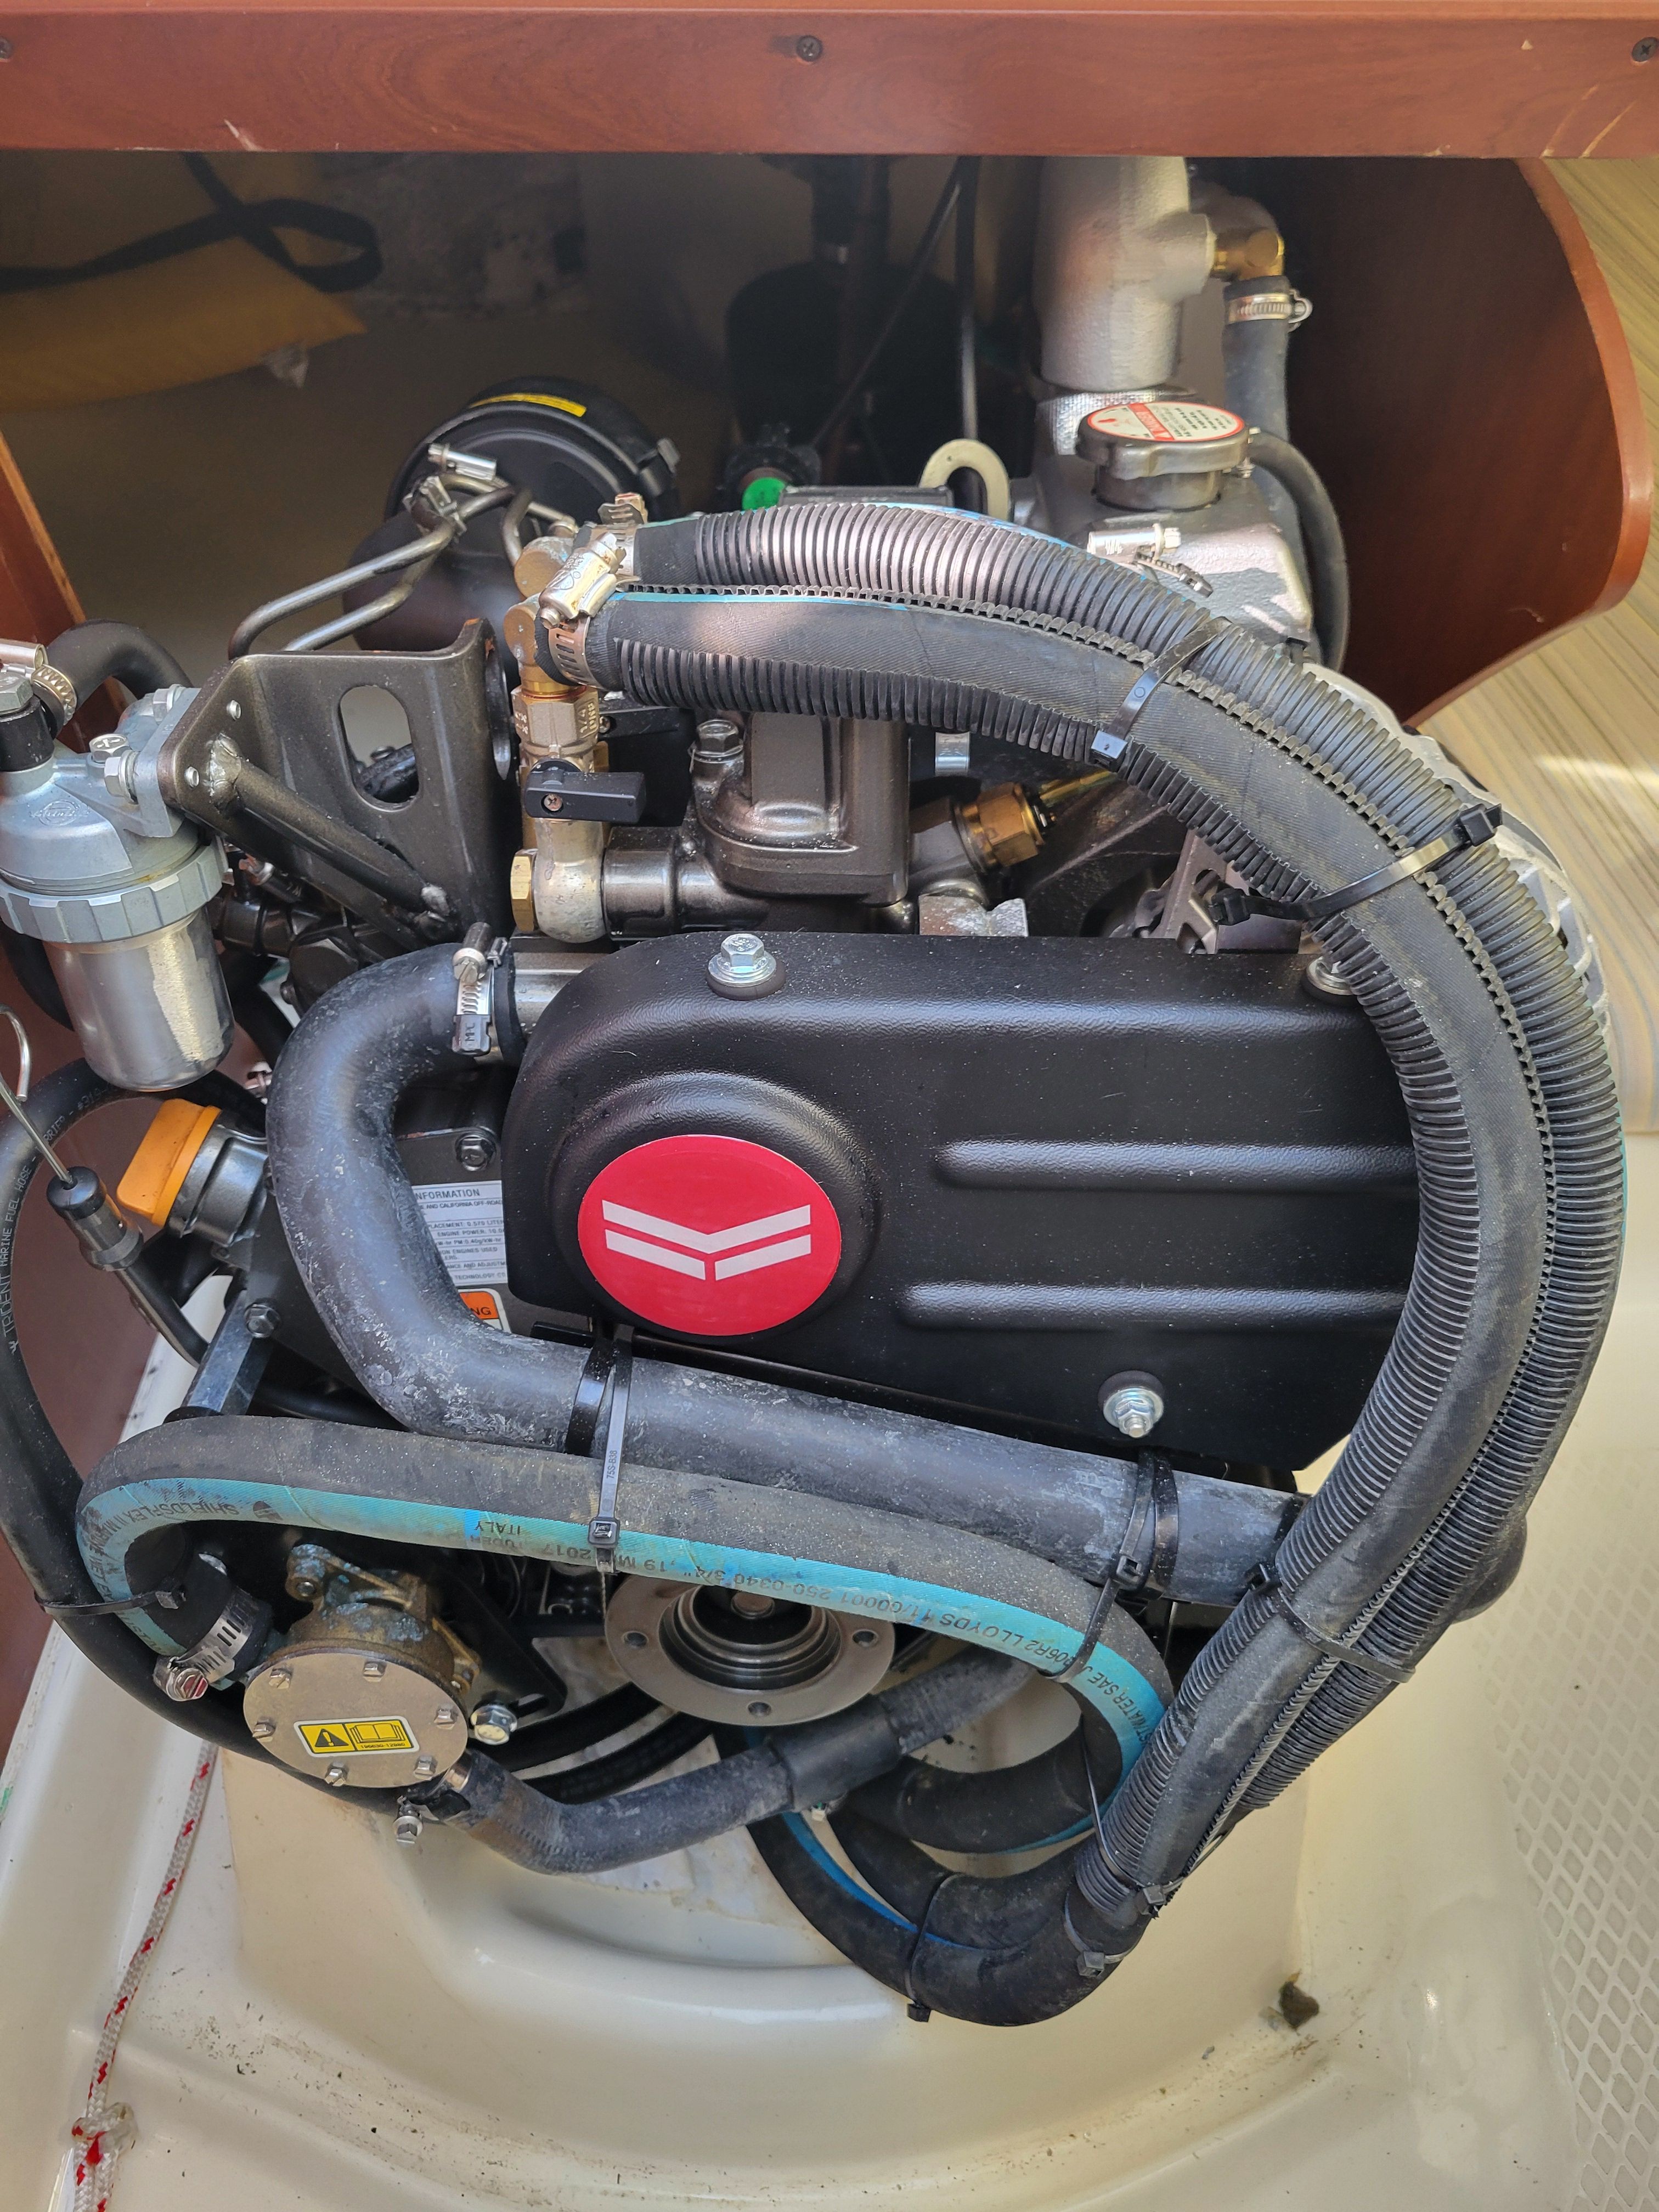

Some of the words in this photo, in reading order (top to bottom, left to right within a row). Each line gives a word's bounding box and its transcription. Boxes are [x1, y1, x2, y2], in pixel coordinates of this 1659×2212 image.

[16, 1165, 32, 1193] HOSE
[415, 1188, 481, 1200] NFORMATION
[5, 1197, 20, 1223] FUEL
[0, 1227, 13, 1267] MARINE
[454, 1272, 495, 1280] TECHNOLOGY
[474, 1520, 521, 1536] ITALY
[939, 1613, 1024, 1647] LLOYDS
[1087, 1671, 1120, 1696] SAE
